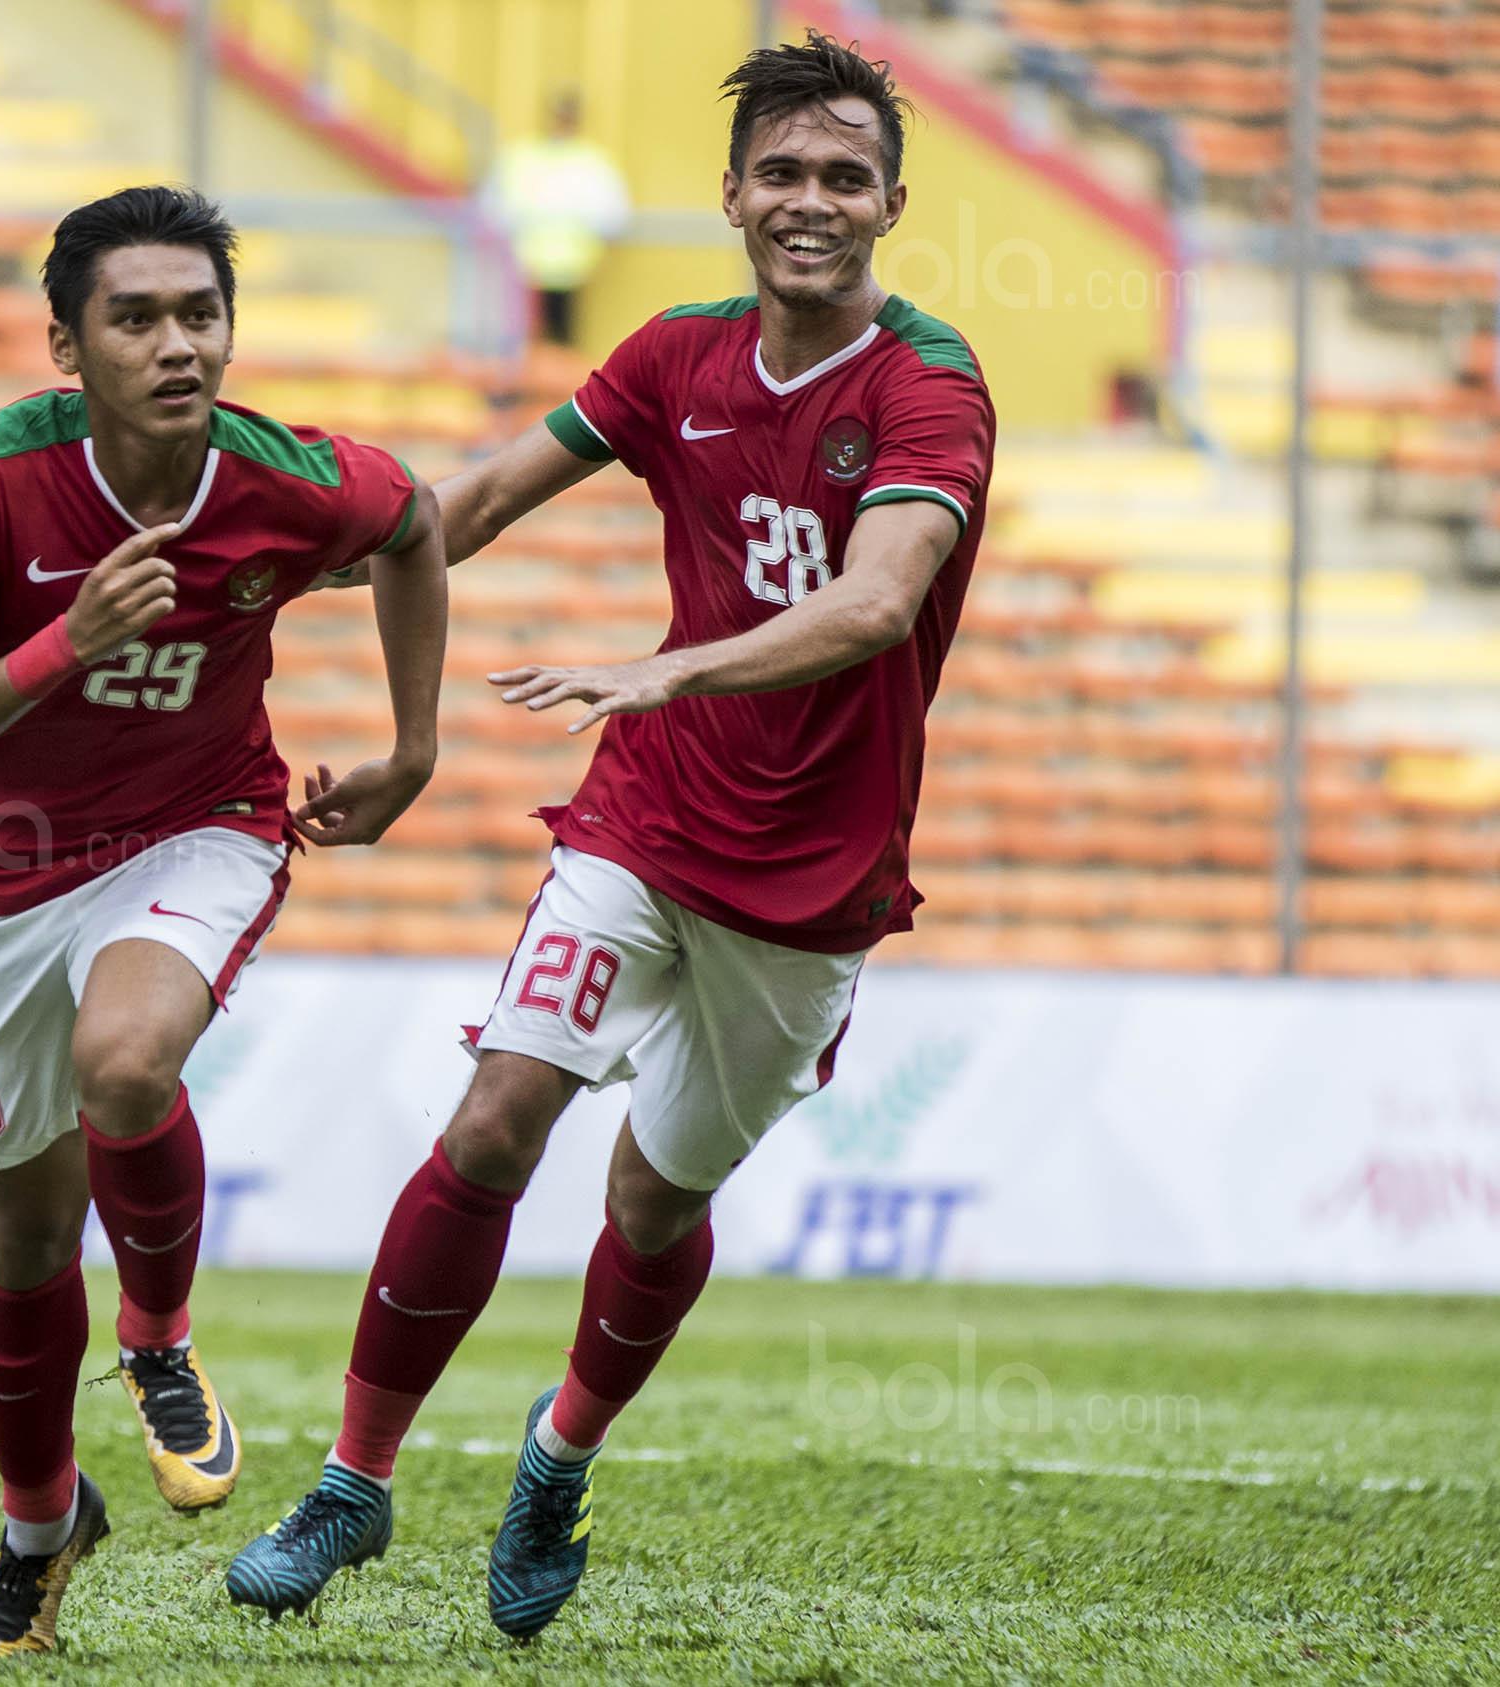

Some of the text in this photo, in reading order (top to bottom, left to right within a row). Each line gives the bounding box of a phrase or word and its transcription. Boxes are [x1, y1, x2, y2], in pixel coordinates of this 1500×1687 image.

[740, 493, 833, 606] 28
[83, 640, 208, 711] 29
[513, 932, 621, 1037] 28
